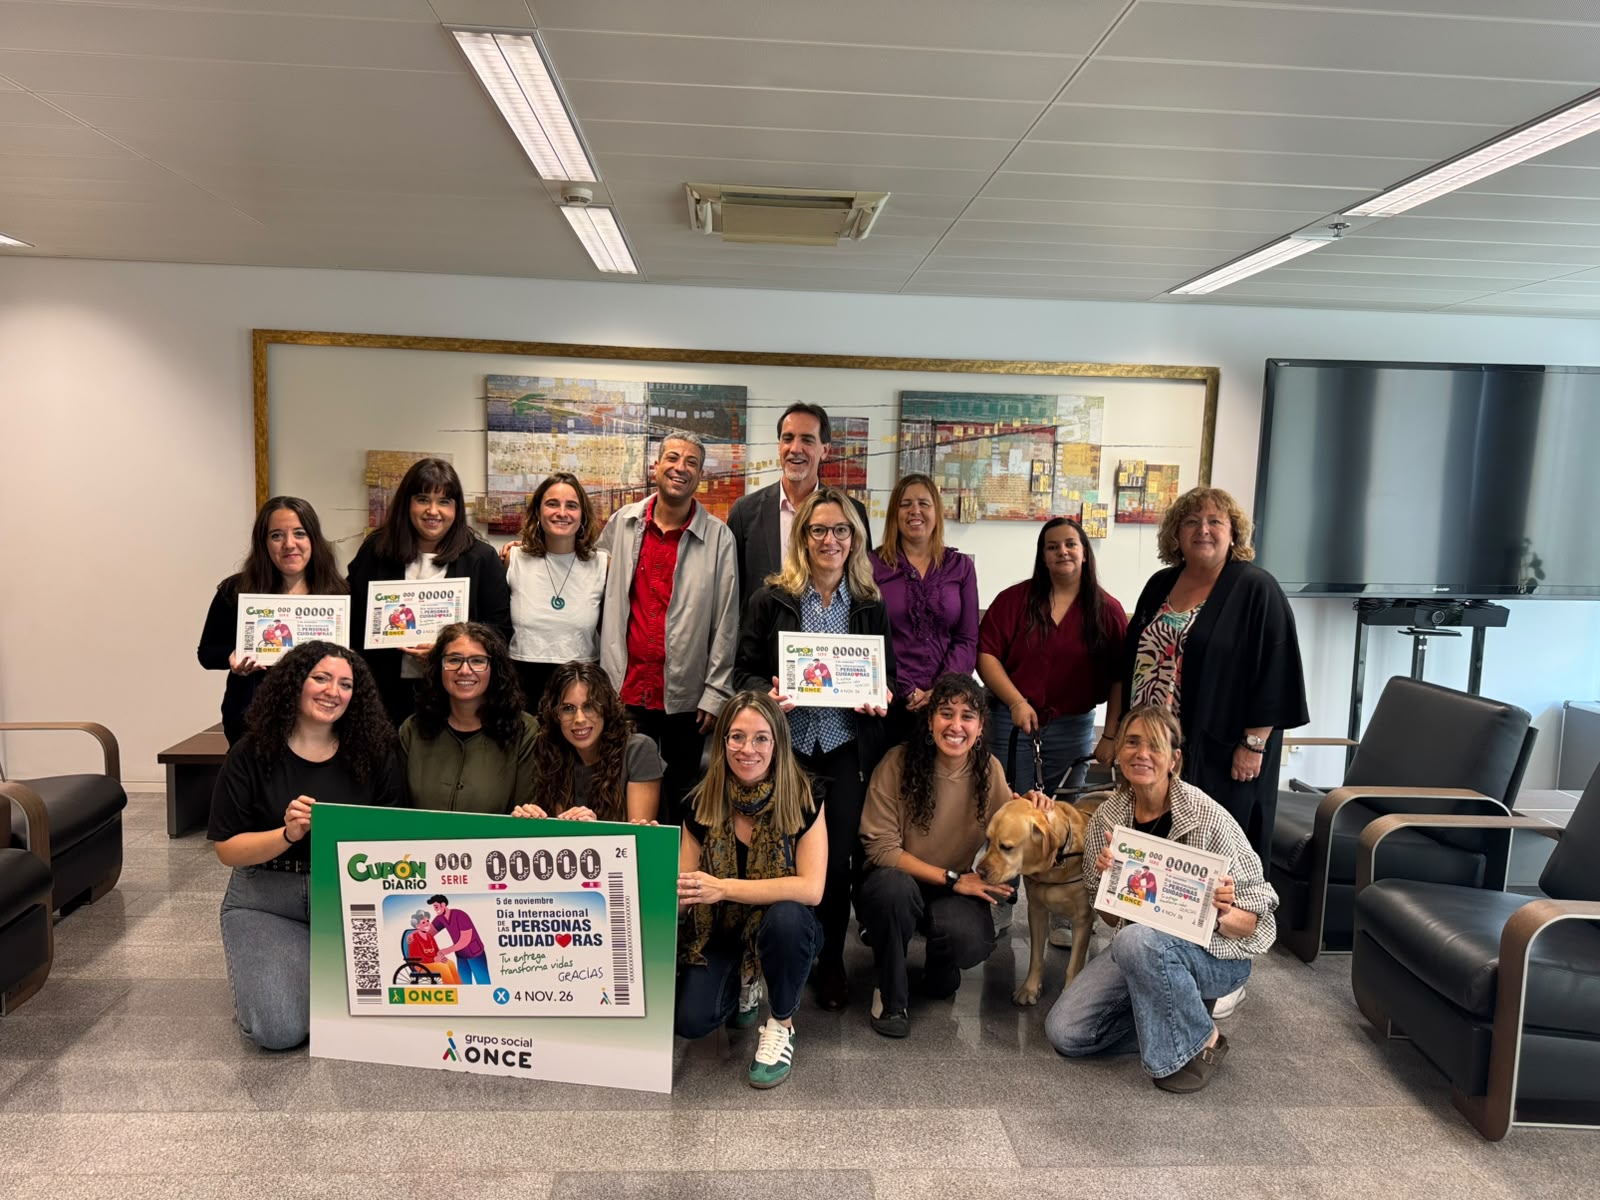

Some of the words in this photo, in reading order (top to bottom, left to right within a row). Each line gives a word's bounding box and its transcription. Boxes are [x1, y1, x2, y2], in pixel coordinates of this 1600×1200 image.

[418, 590, 454, 600] 00000
[295, 607, 334, 617] 00000
[832, 646, 870, 657] 00000
[615, 848, 628, 858] 2€
[1148, 851, 1163, 861] 000
[347, 853, 427, 882] CUPÓN
[435, 852, 472, 871] 000
[485, 848, 602, 881] 00000
[1166, 856, 1209, 878] 00000
[441, 875, 468, 885] SERIE
[496, 897, 501, 905] 5
[1124, 896, 1142, 906] ONCE
[496, 908, 514, 919] Día
[518, 908, 588, 918] Internacional
[512, 919, 591, 933] PERSONAS
[499, 953, 511, 964] Tu
[513, 951, 546, 965] entrega
[500, 961, 548, 976] transforma
[550, 956, 574, 970] vidas
[408, 990, 455, 1002] ONCE
[514, 991, 521, 1002] 4
[525, 991, 557, 1001] NOV.
[559, 990, 574, 1001] 26
[464, 1034, 498, 1046] grupo
[501, 1037, 533, 1048] social
[464, 1046, 532, 1069] ONCE
